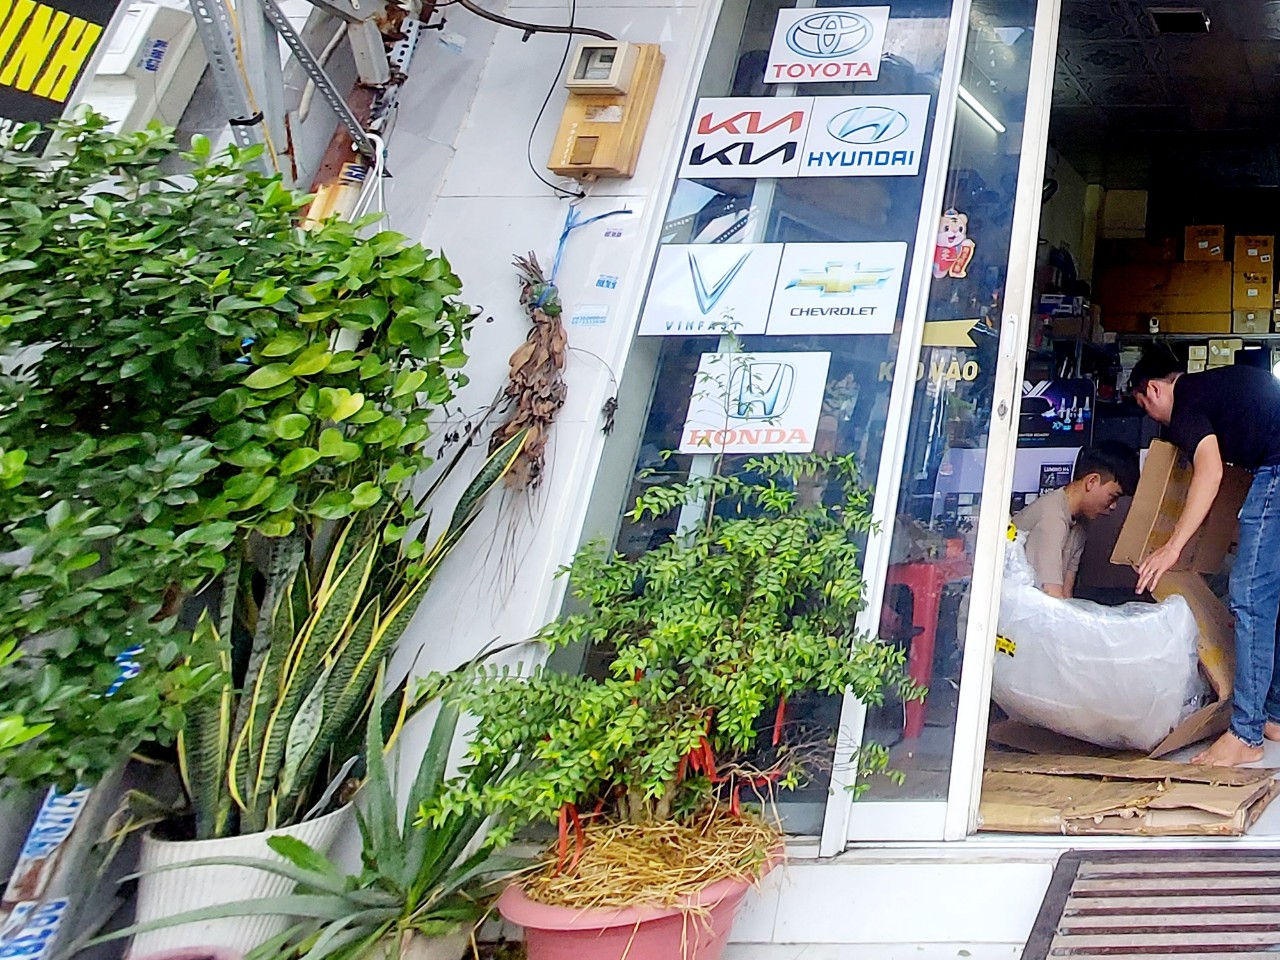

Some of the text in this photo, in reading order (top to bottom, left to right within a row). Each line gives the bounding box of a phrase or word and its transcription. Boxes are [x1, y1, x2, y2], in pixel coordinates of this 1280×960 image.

[772, 61, 873, 79] TOYOTA
[696, 110, 805, 136] KIA
[689, 141, 797, 166] KIA
[807, 150, 915, 167] HYUNDAI
[789, 306, 878, 317] CHEVROLET
[687, 428, 810, 446] HONDA
